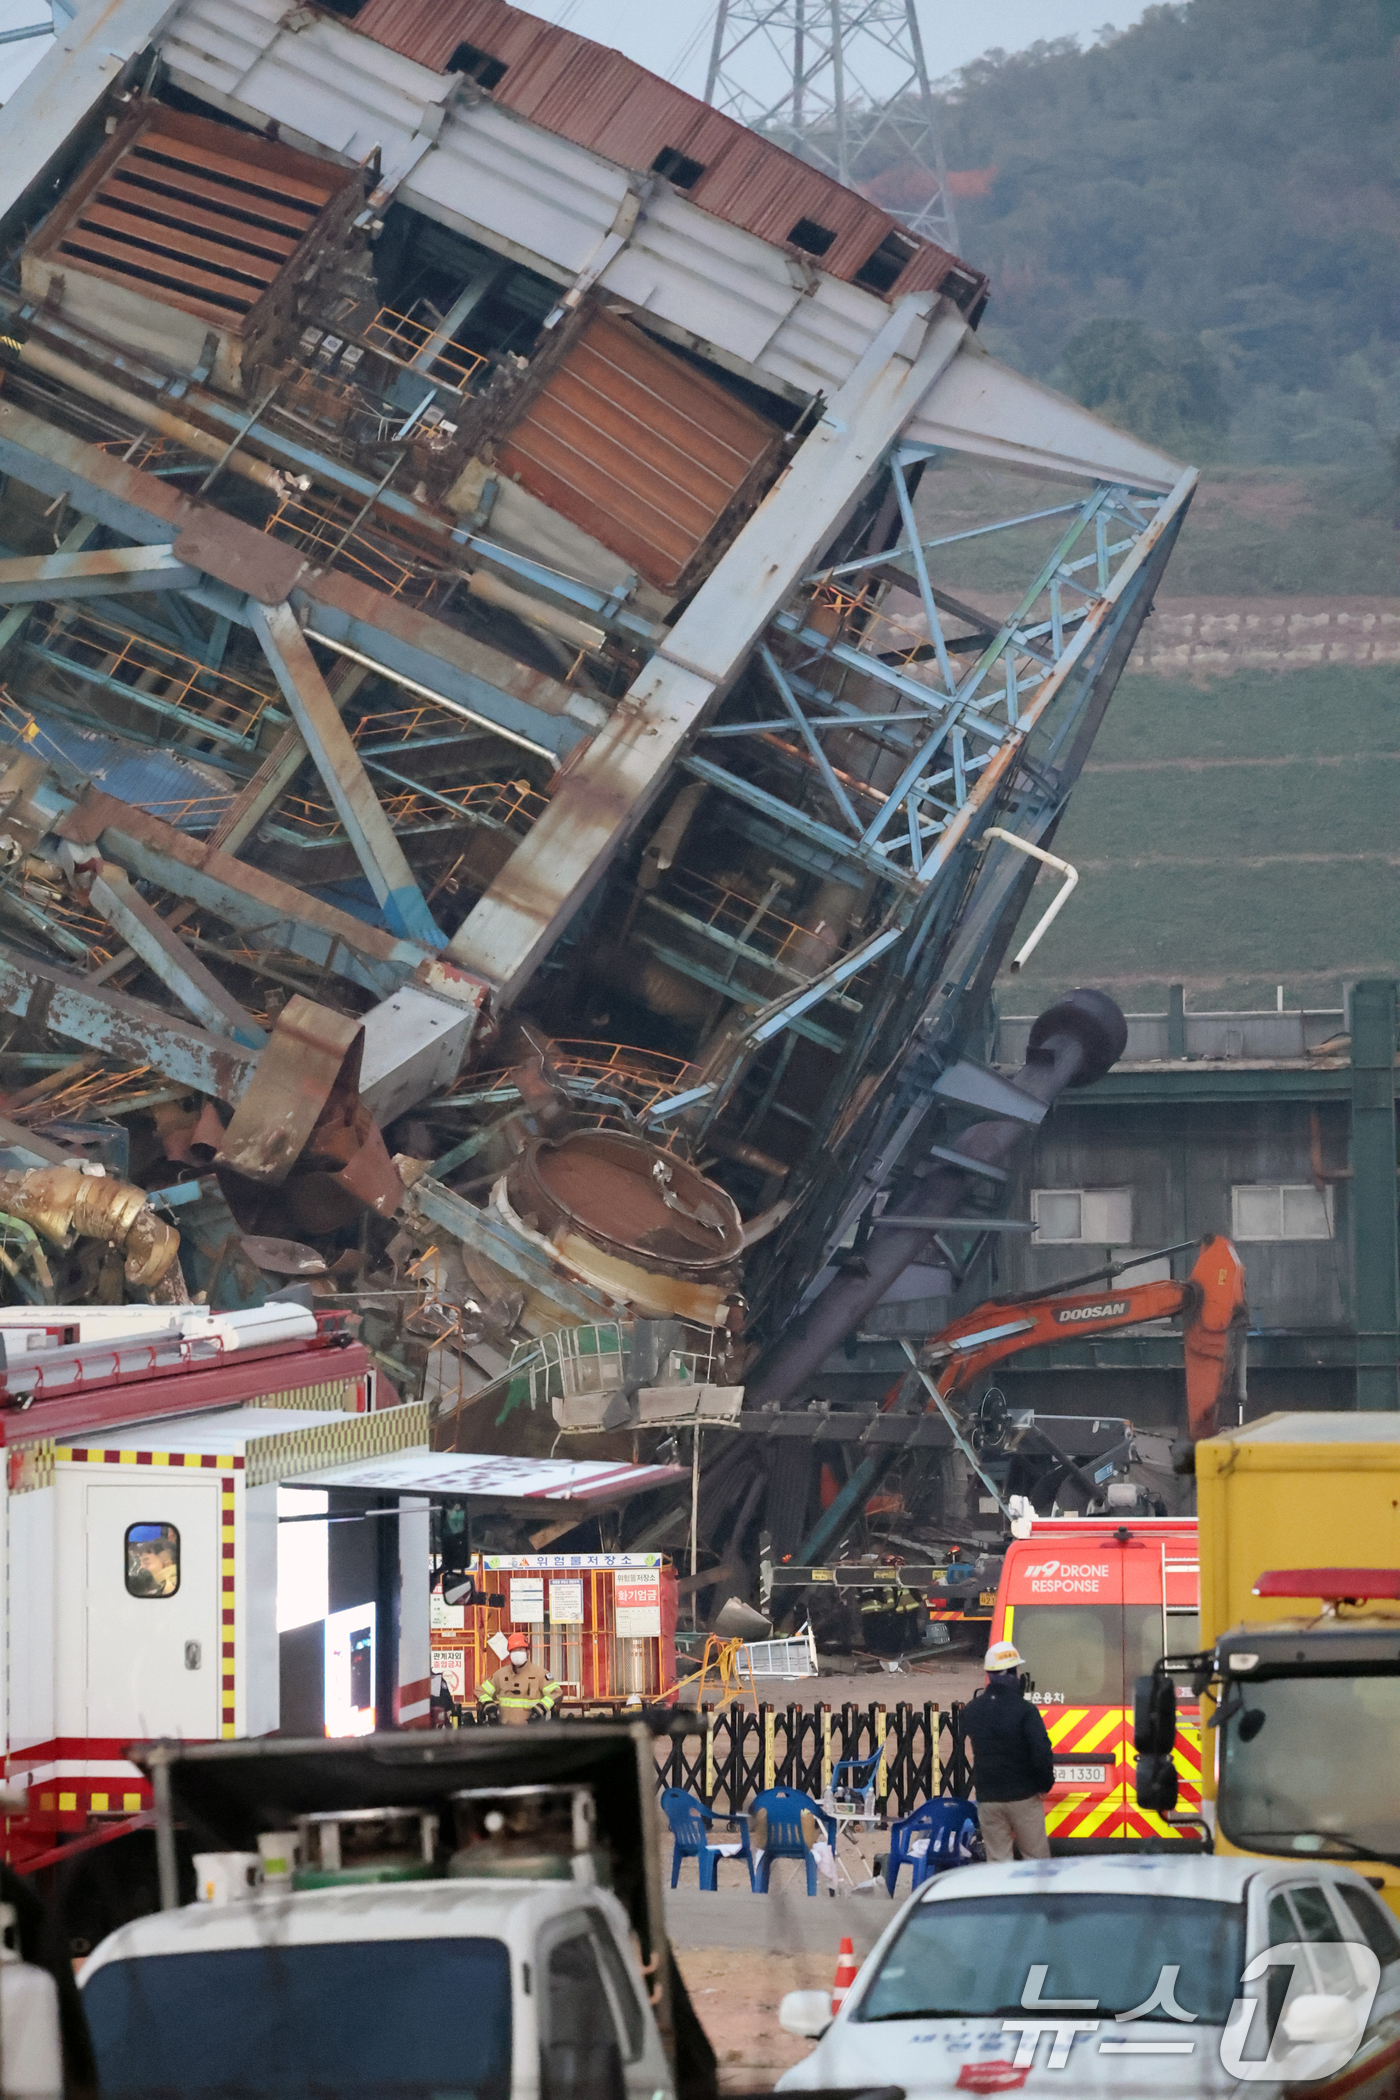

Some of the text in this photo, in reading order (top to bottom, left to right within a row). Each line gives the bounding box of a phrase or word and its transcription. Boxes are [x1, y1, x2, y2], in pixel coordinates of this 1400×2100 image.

[1059, 1303, 1125, 1322] DOOSAN
[536, 1556, 632, 1566] 위험물저장소
[1023, 1560, 1109, 1578] 119 DRONE
[617, 1574, 656, 1582] 위험물저장소
[1031, 1579, 1099, 1593] RESPONSE
[618, 1589, 657, 1602] 화기엄금
[433, 1652, 462, 1660] 관계자외
[433, 1660, 462, 1668] 출입금지
[1069, 1768, 1101, 1780] 1330
